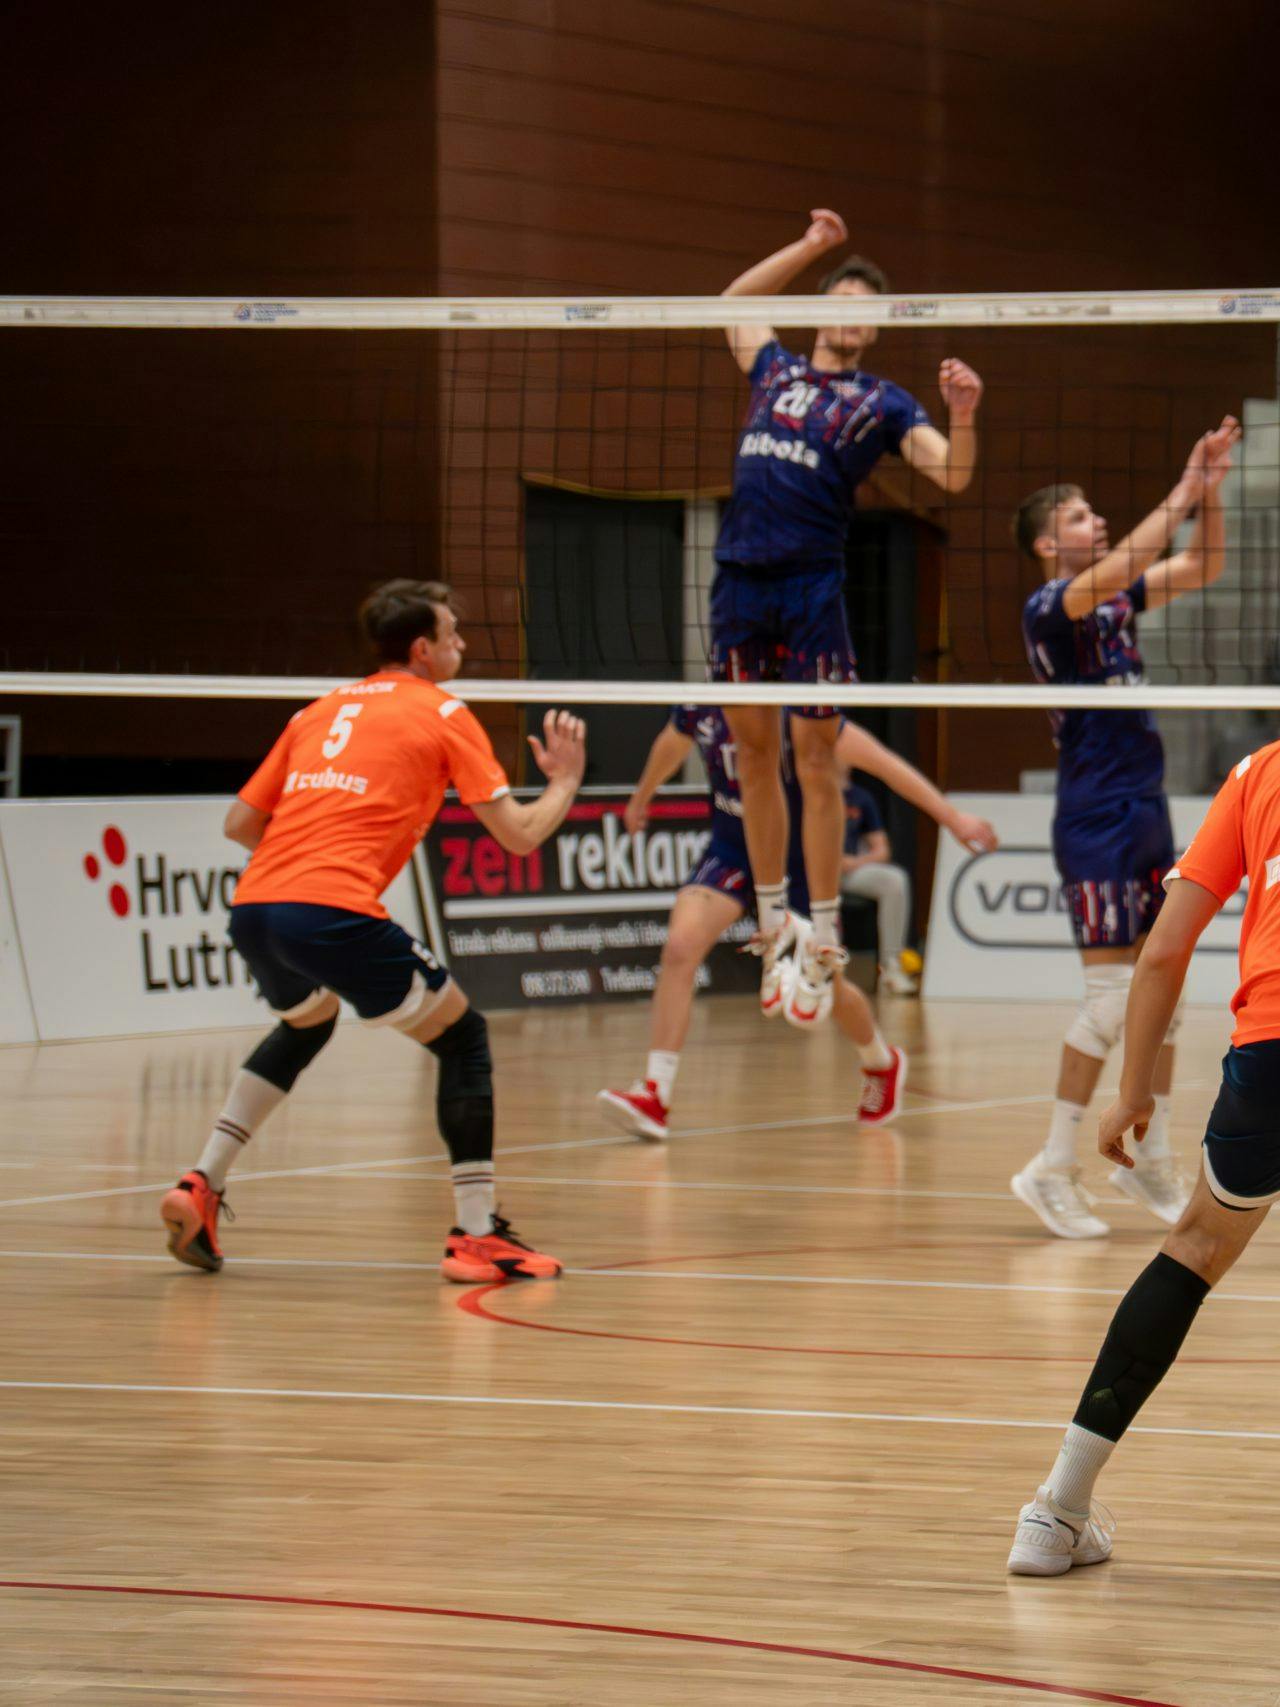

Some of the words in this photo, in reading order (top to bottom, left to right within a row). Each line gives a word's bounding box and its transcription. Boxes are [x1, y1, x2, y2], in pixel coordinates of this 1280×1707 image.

[322, 703, 364, 760] 5
[297, 766, 369, 796] cubus
[439, 835, 544, 896] zen
